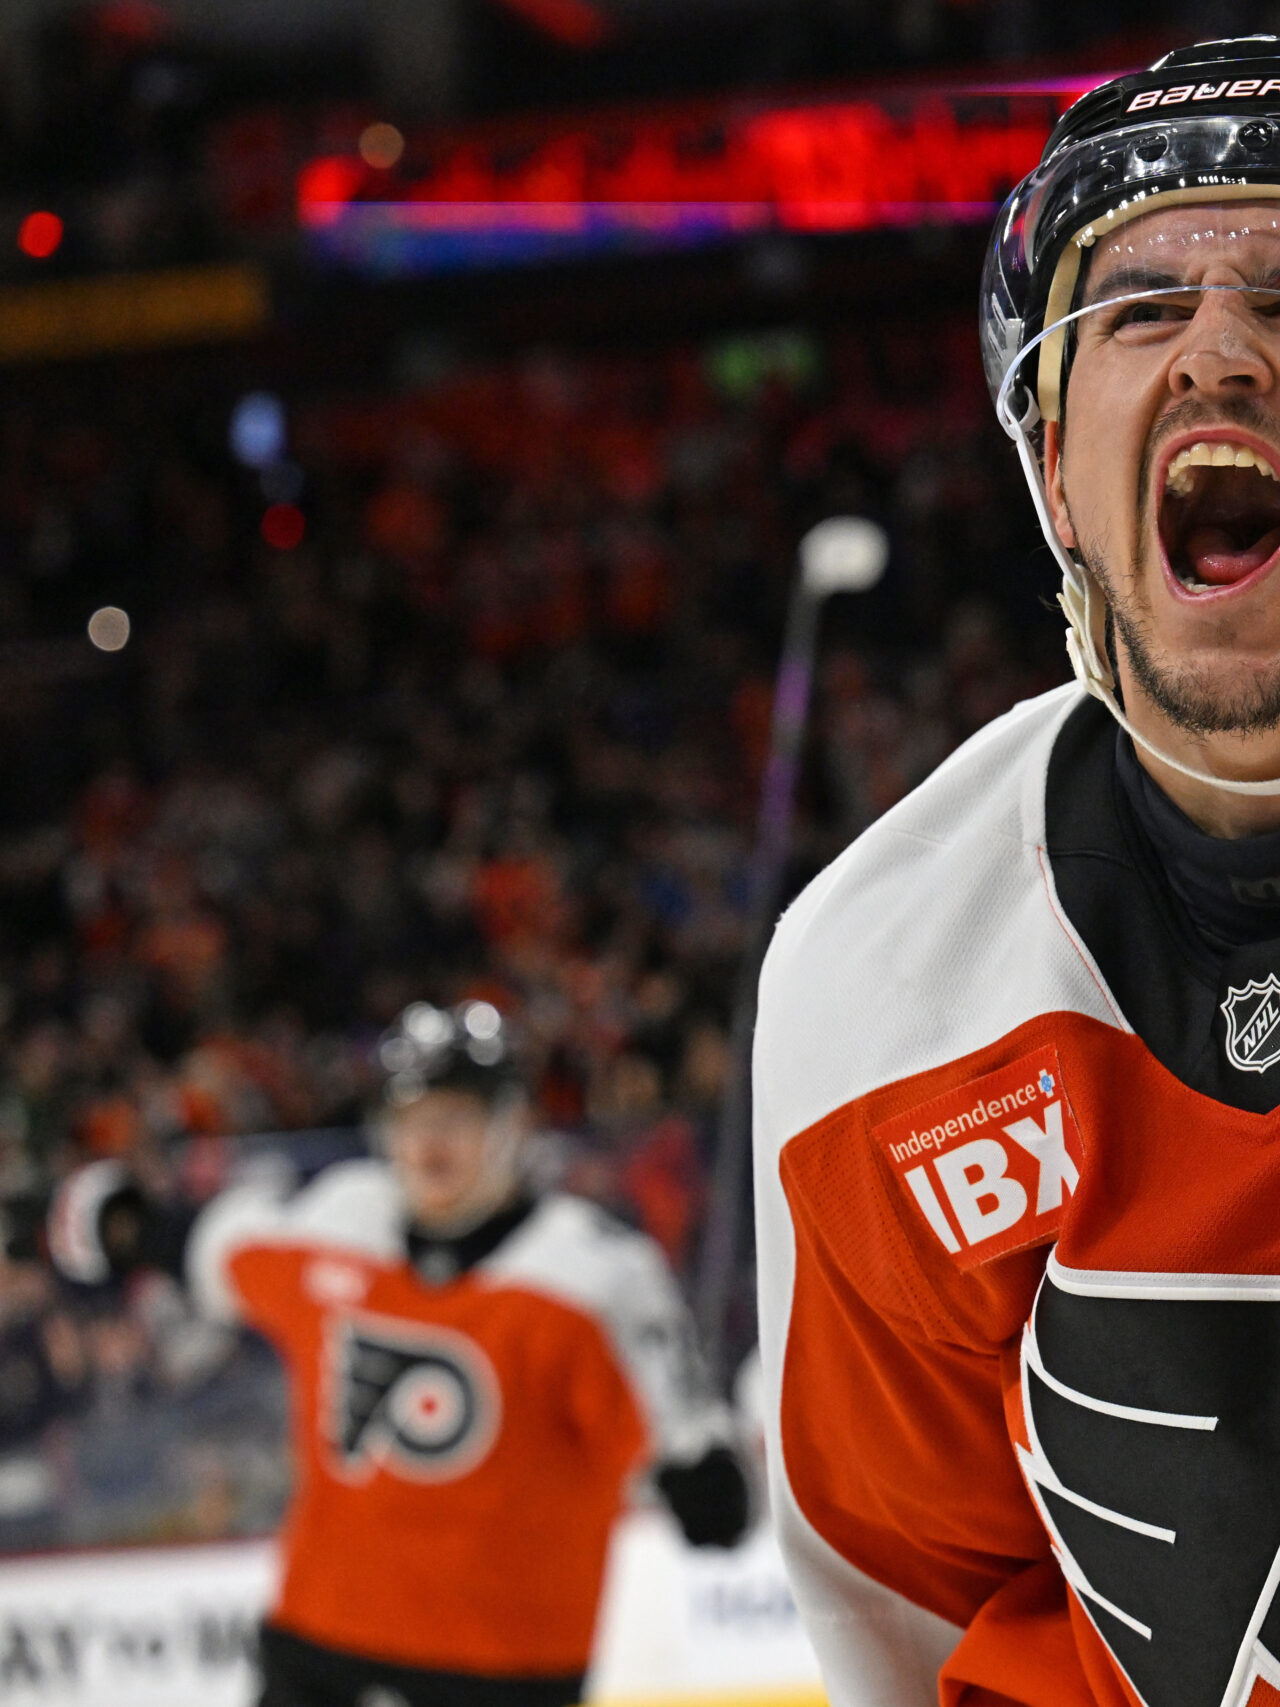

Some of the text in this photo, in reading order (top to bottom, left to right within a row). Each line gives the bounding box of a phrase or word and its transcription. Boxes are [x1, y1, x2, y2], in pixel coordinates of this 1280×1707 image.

[1242, 1001, 1280, 1057] NHL
[889, 1083, 1037, 1163] Independence
[904, 1100, 1080, 1255] IBX
